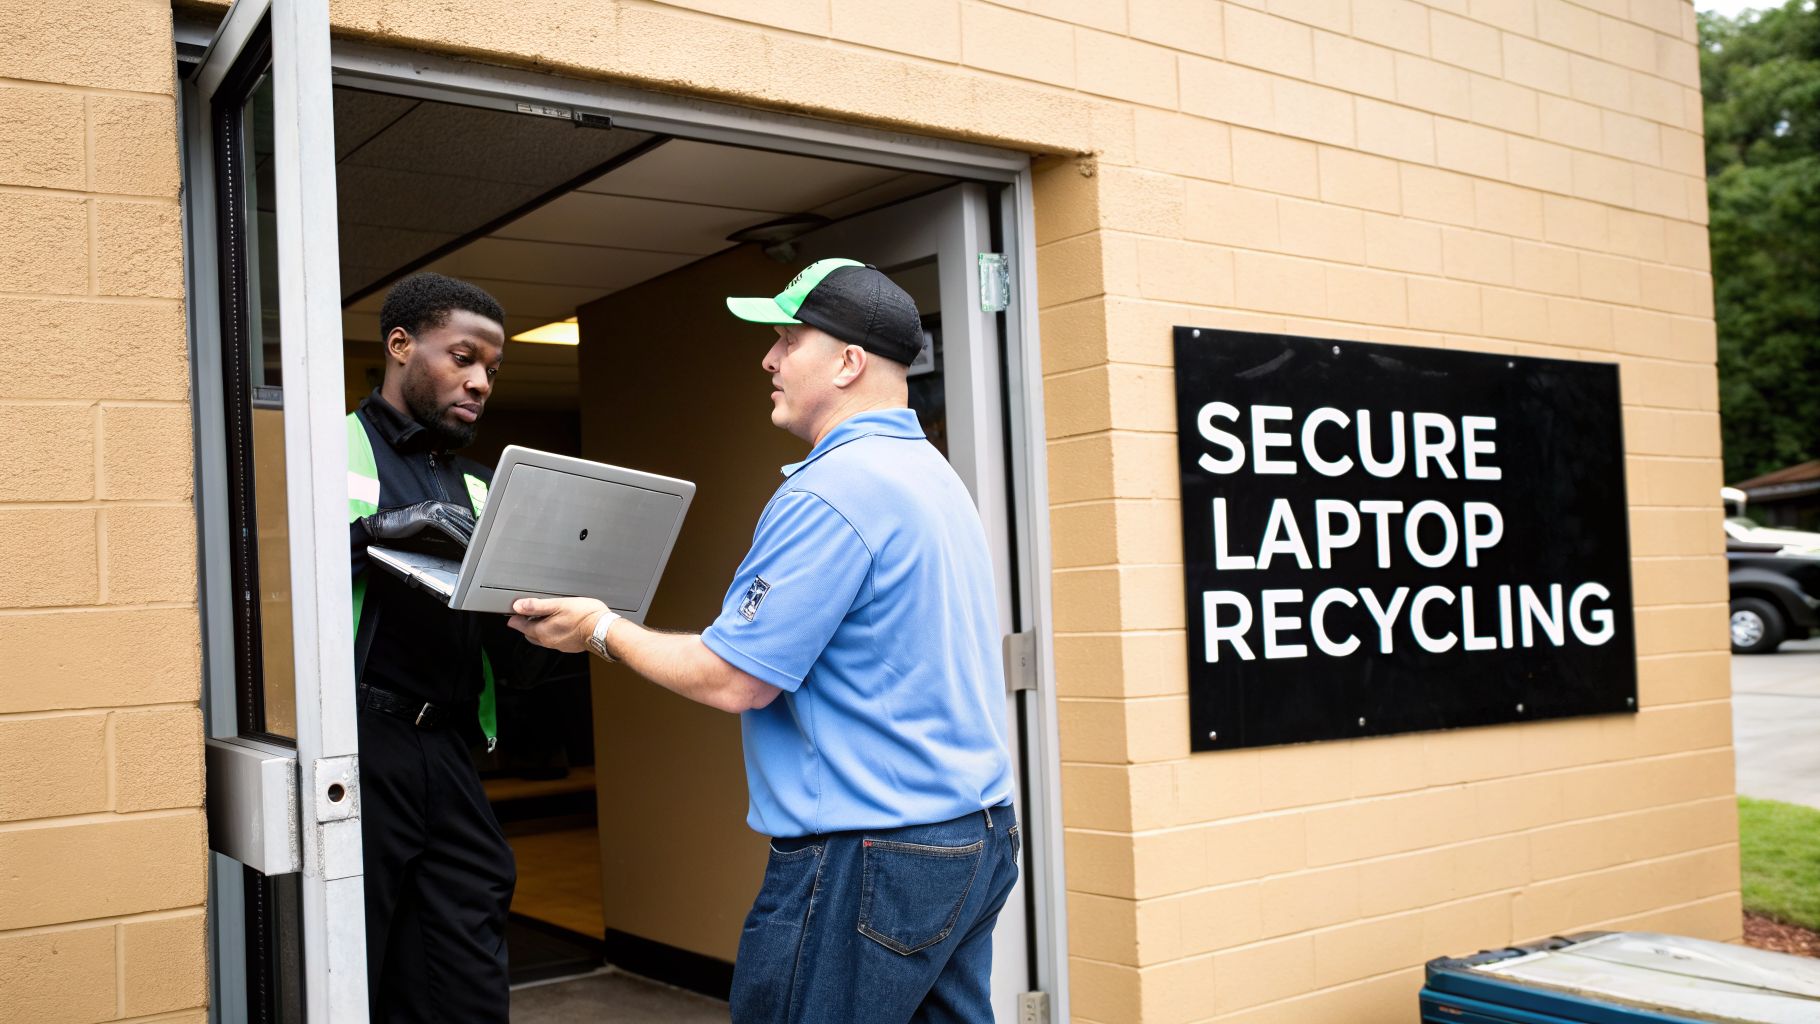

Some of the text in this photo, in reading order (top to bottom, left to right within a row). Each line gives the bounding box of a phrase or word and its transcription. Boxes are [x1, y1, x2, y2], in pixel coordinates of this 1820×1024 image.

[1197, 401, 1502, 480] SECURE
[1212, 497, 1504, 570] LAPTOP
[1202, 582, 1615, 663] RECYCLING
